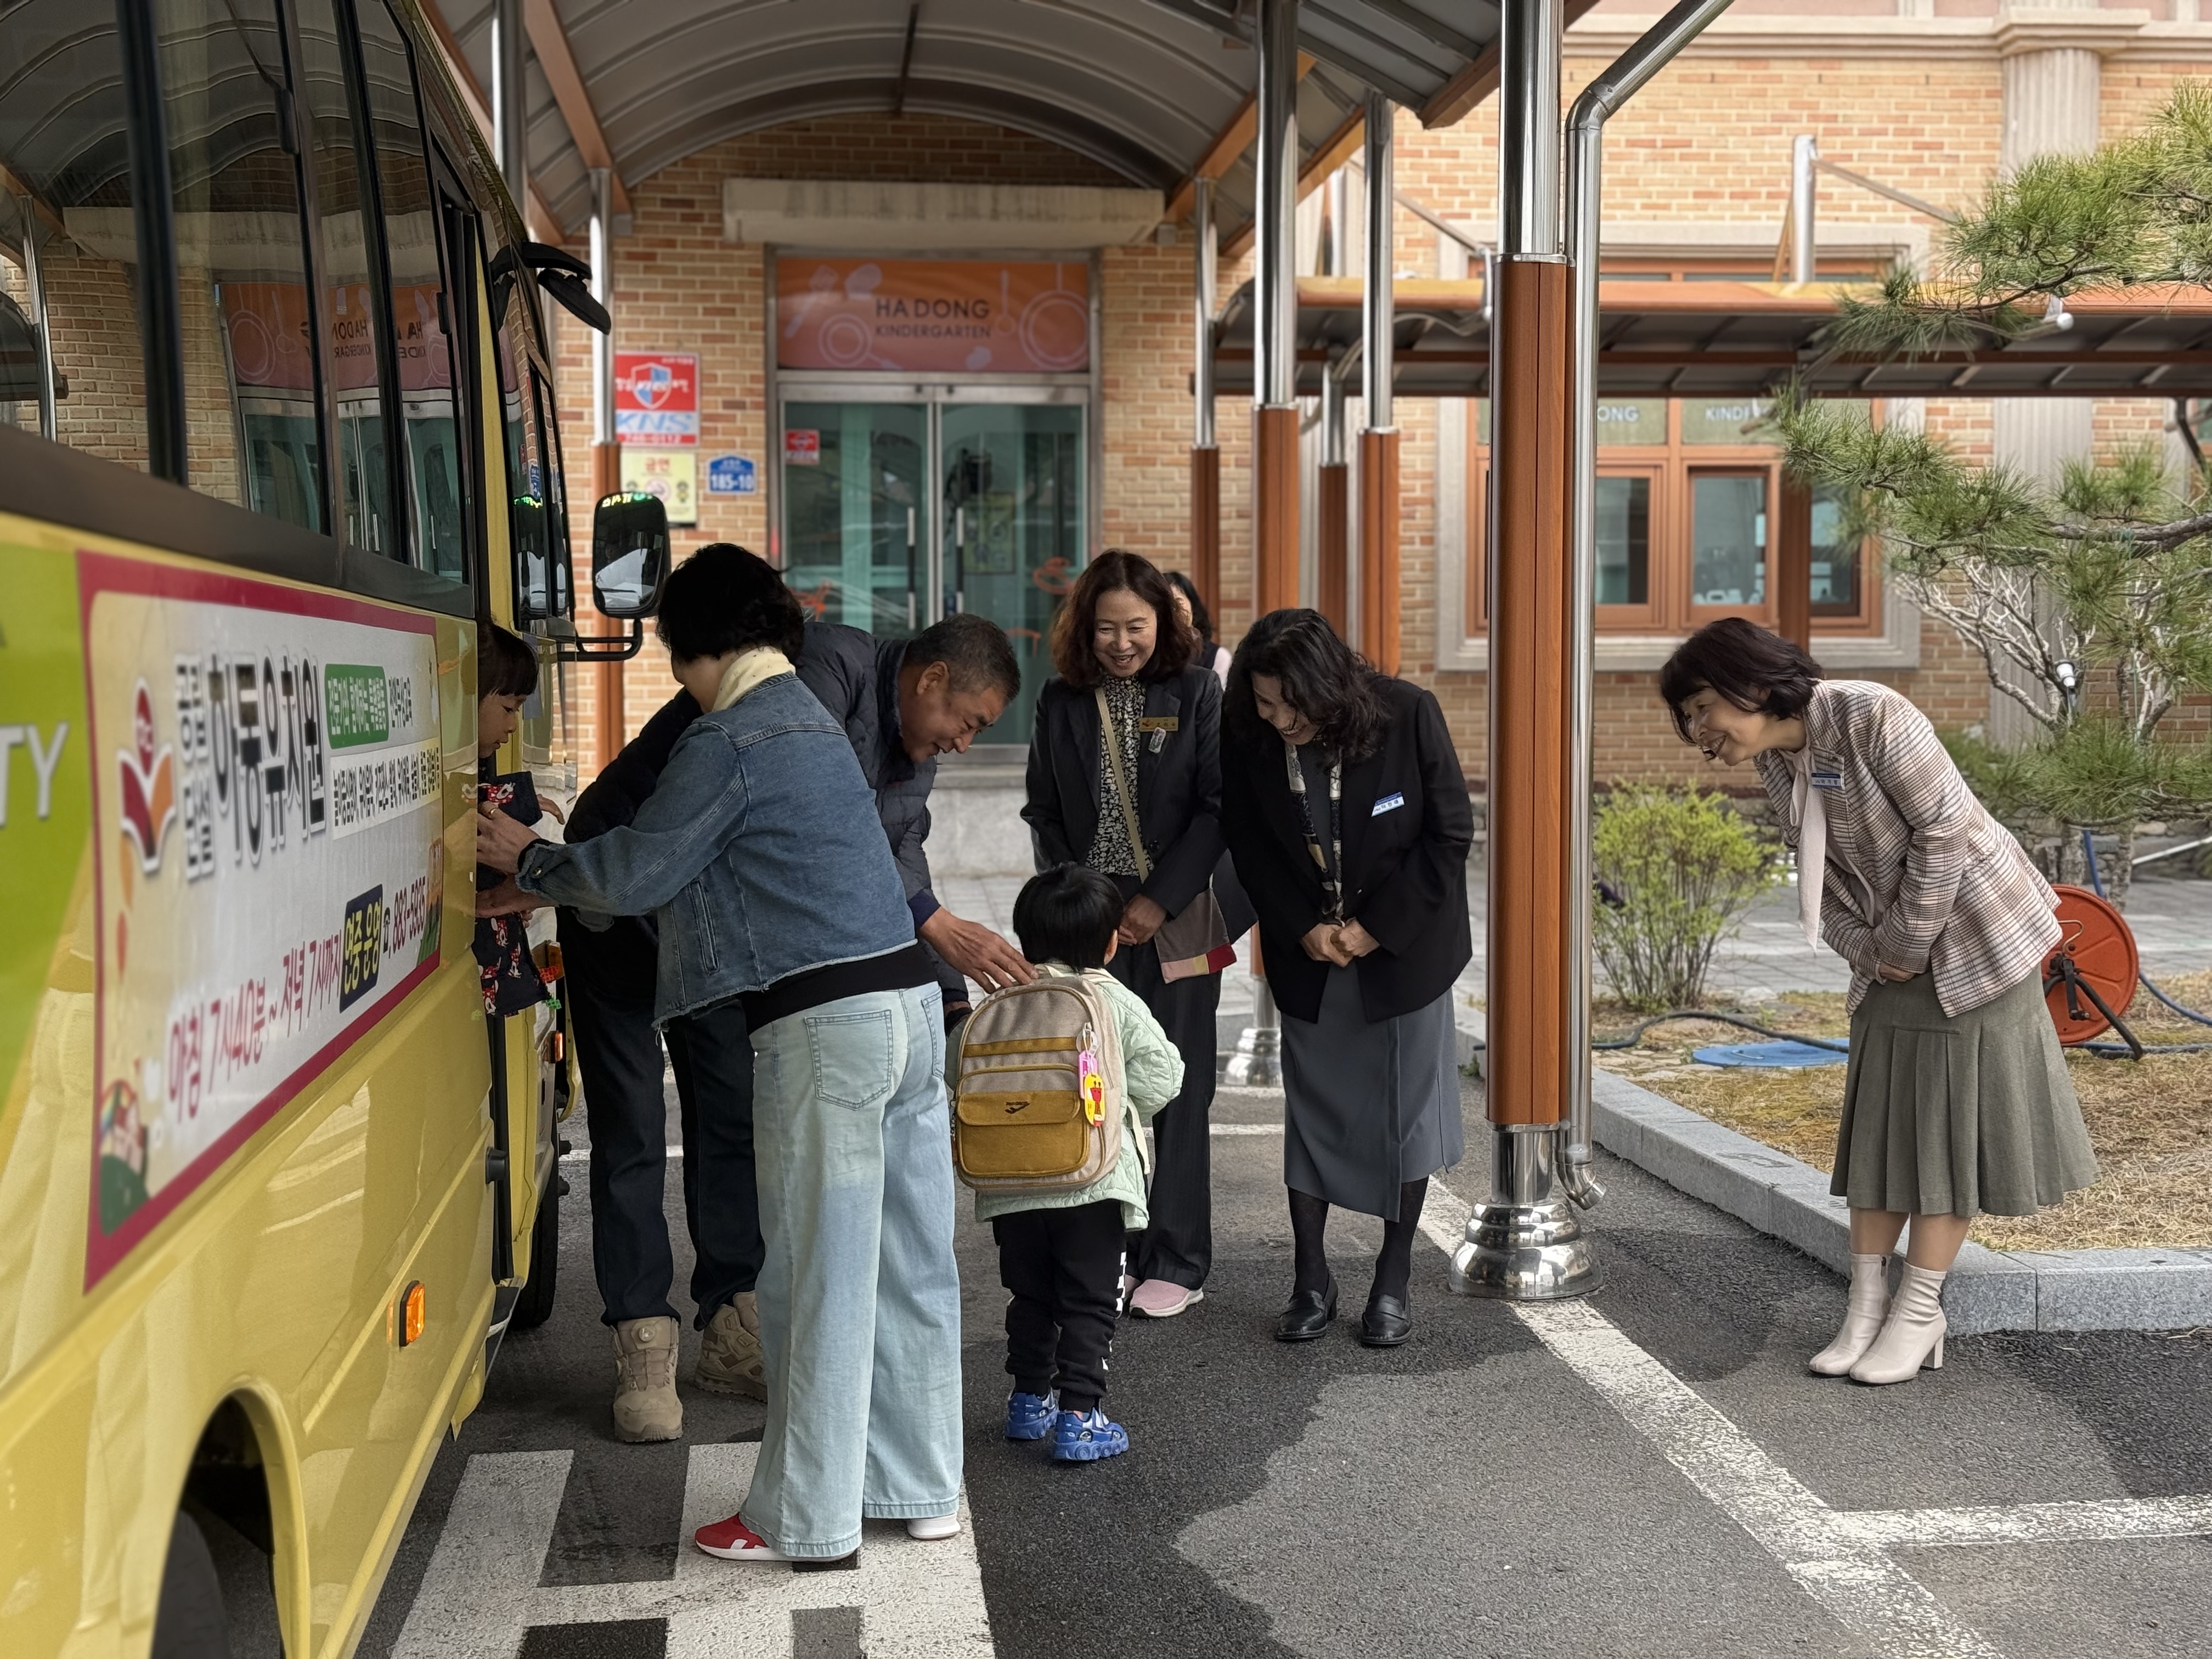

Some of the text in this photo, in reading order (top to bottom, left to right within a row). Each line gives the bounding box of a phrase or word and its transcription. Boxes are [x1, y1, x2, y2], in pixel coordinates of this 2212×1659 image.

[877, 324, 991, 338] KINDERGARTEN
[712, 475, 753, 490] 185-10
[207, 653, 326, 856] 하동유치원
[169, 1001, 204, 1124] 아침
[208, 977, 266, 1094] 7시40분
[280, 941, 305, 1037] 저녁
[307, 929, 341, 1018] 7시까지
[345, 909, 363, 995] 연중
[363, 896, 382, 981] 운영
[393, 876, 426, 954] 883-5935
